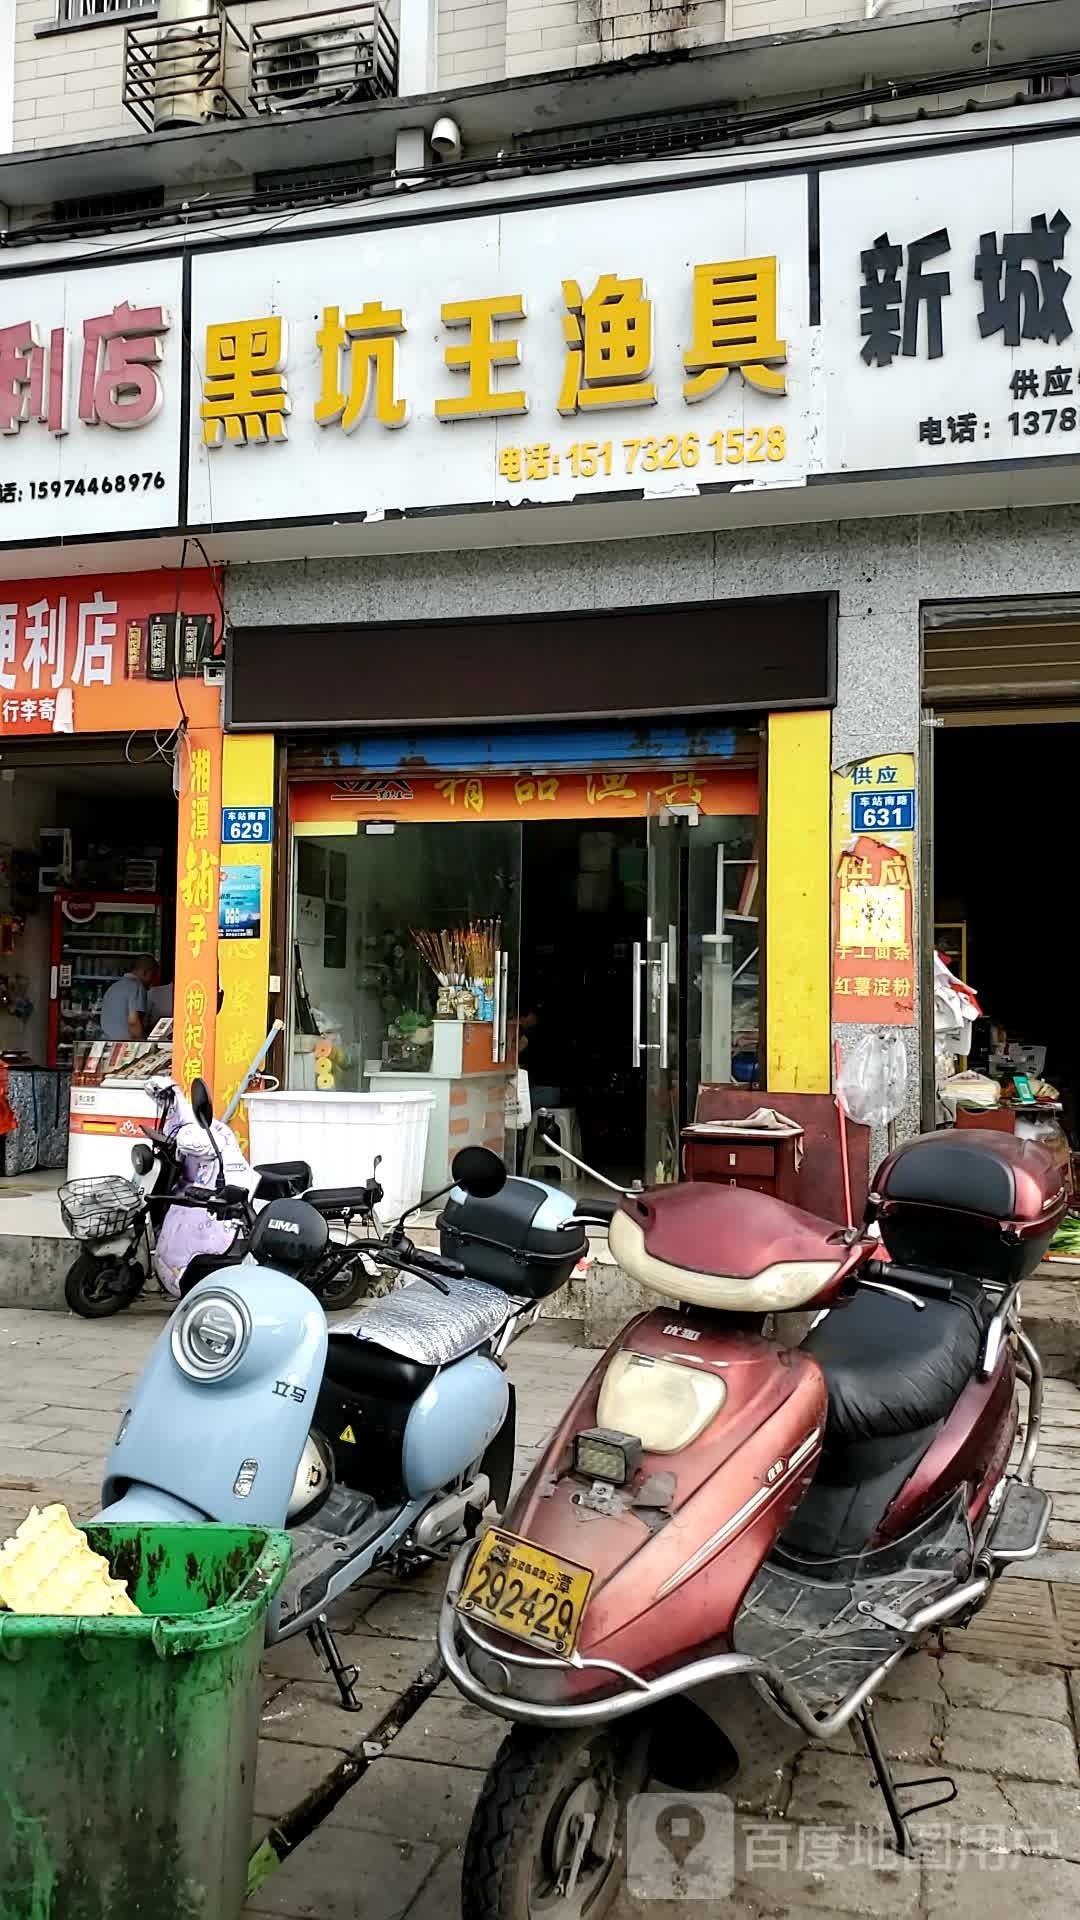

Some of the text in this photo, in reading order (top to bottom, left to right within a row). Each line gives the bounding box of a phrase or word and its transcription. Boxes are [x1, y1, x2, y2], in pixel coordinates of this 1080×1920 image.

[859, 209, 1074, 369] 新城
[199, 256, 788, 450] 黑坑王渔具
[1009, 364, 1080, 400] 供应
[623, 432, 699, 474] 7326
[709, 425, 786, 465] 1528
[851, 766, 898, 785] 供应
[859, 795, 908, 807] 车站南路
[227, 811, 266, 821] 车站南路
[863, 807, 902, 827] 631
[230, 822, 263, 839] 629
[834, 976, 911, 997] 红薯淀粉
[267, 1219, 300, 1234] LIMA
[469, 1565, 574, 1639] 292429
